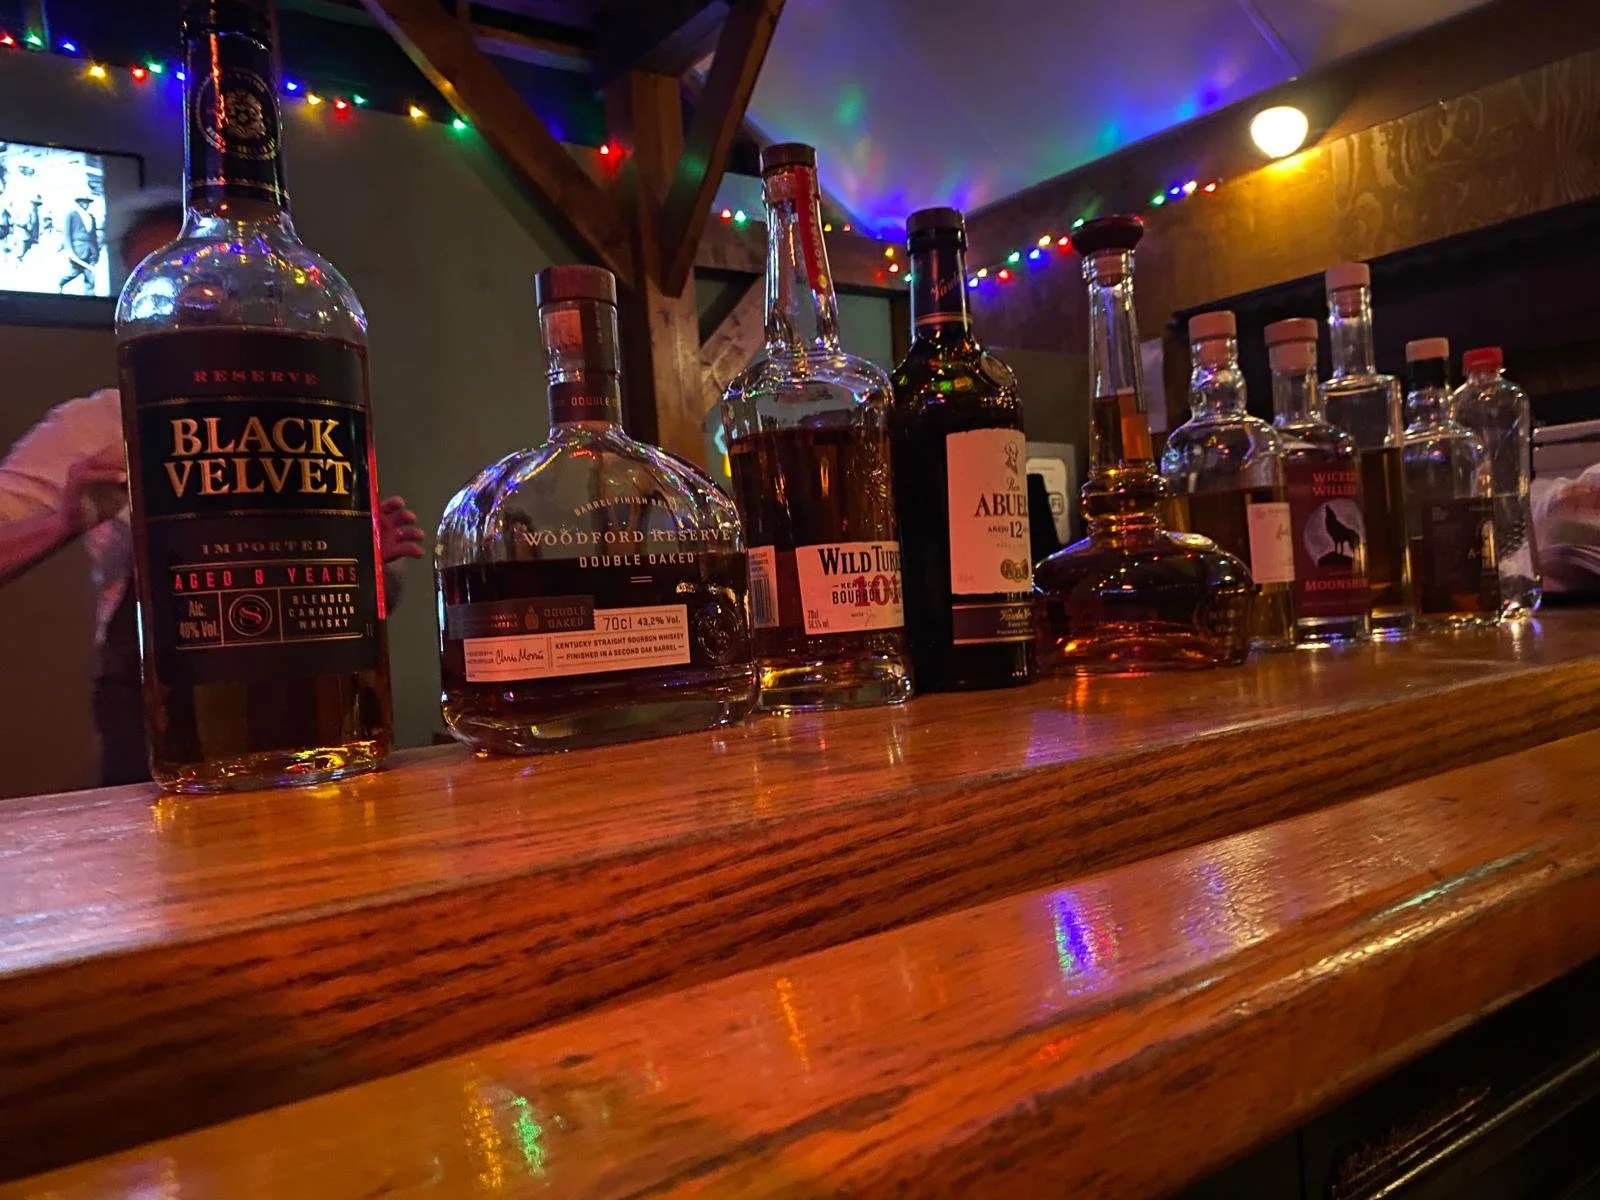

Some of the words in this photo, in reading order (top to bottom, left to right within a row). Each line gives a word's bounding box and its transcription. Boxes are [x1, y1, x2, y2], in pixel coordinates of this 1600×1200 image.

[193, 370, 319, 385] RESERVE
[170, 416, 344, 457] BLACK
[164, 458, 352, 498] VELVET
[523, 530, 645, 547] WOODFORD
[651, 528, 732, 542] RESERVE
[1010, 521, 1023, 538] 12
[202, 540, 328, 555] IMPORTED
[579, 554, 641, 568] DOUBLE
[649, 552, 695, 565] OAKED
[817, 547, 872, 576] WILD
[174, 570, 233, 590] AGED
[255, 569, 265, 585] 8
[287, 566, 357, 584] YEARS
[292, 593, 351, 605] BLENDED
[288, 606, 355, 618] CANADIAN
[543, 606, 586, 618] DOUBLE
[298, 618, 349, 629] WHISKY
[547, 616, 584, 629] OAKED
[603, 616, 632, 631] 70cl
[665, 615, 681, 625] Vol.
[555, 640, 592, 649] KENTUCKY
[593, 637, 626, 647] STRAIGHT
[627, 635, 657, 644] BOURBON
[658, 632, 684, 641] WHISKEY
[566, 651, 599, 660] FINISHED
[613, 647, 640, 656] SECOND
[653, 644, 677, 653] BARREL
